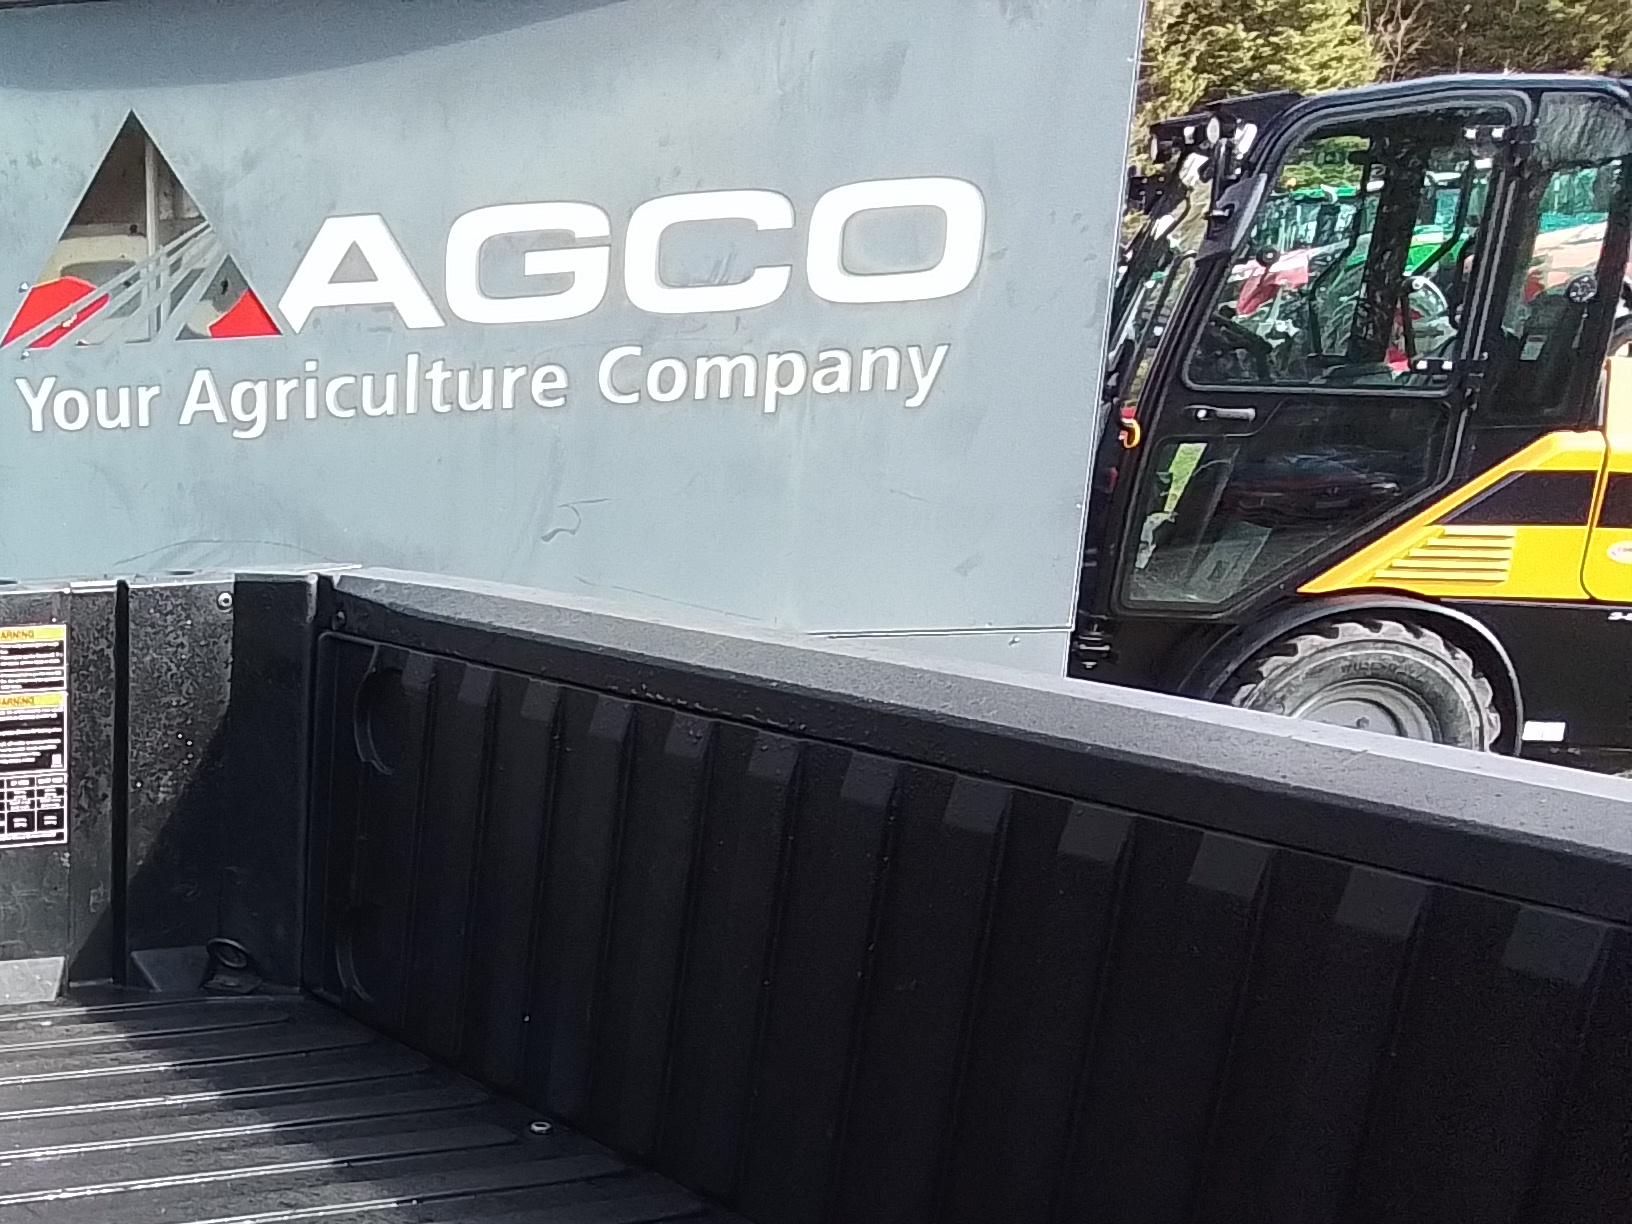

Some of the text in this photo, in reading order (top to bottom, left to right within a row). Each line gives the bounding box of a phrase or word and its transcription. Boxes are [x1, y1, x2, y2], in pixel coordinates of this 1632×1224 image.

[278, 176, 986, 334] AGCO
[15, 342, 952, 440] Your Agriculture Company
